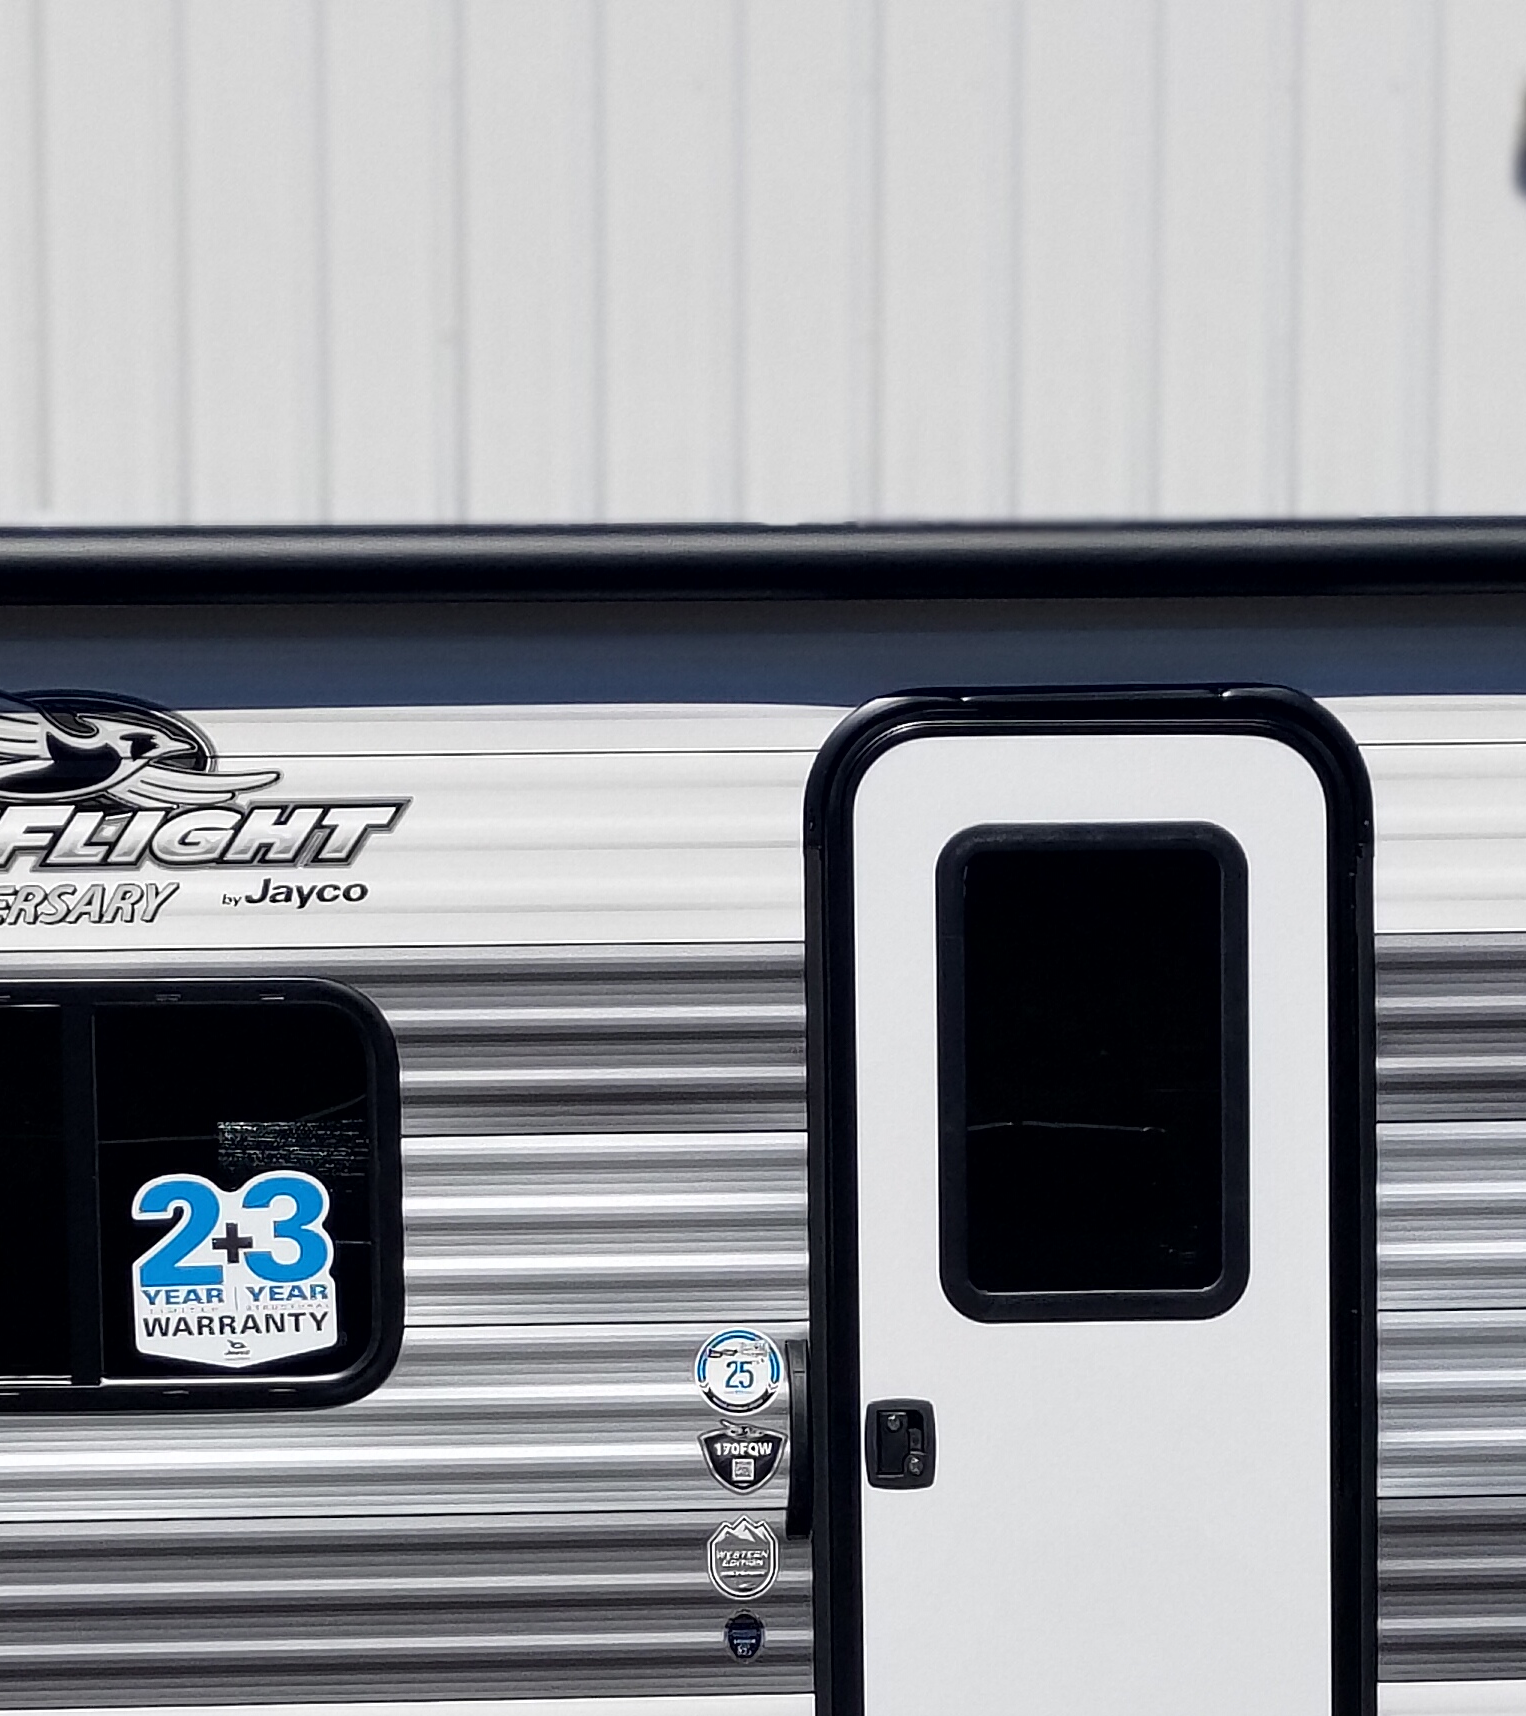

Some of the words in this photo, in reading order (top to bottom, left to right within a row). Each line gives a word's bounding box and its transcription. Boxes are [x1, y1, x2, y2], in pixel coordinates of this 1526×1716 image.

[222, 893, 242, 909] by
[244, 876, 369, 910] Jayco
[142, 1287, 224, 1305] YEAR
[246, 1284, 329, 1301] YEAR
[143, 1311, 329, 1337] WARRANTY
[725, 1360, 755, 1388] 25
